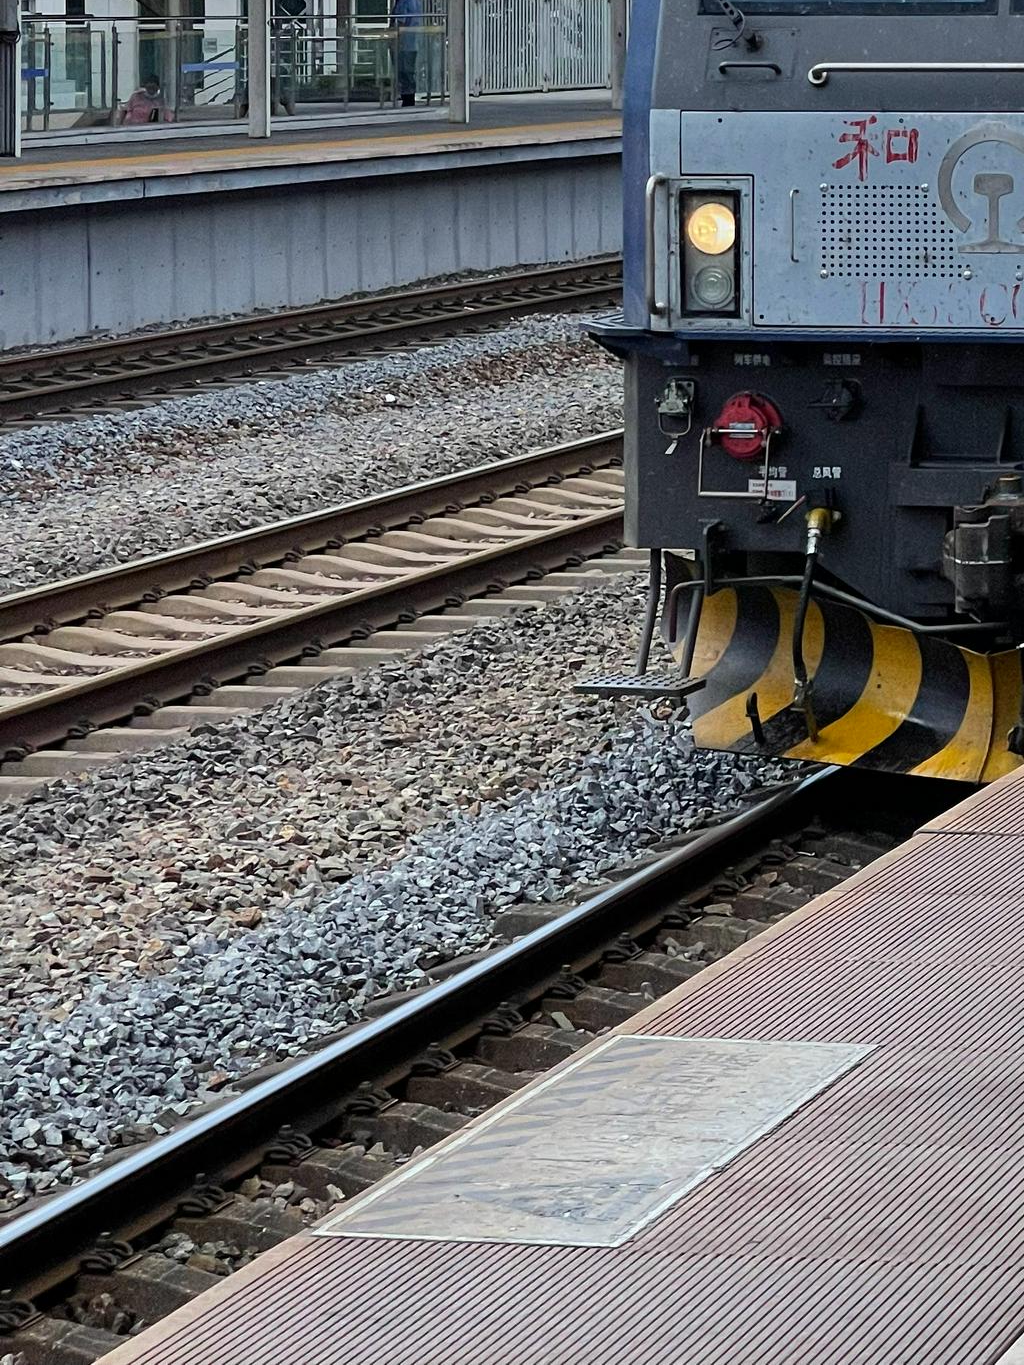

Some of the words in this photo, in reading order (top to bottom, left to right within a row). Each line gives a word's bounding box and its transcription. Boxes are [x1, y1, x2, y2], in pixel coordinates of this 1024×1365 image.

[832, 115, 919, 182] 和
[812, 466, 842, 479] 总风管
